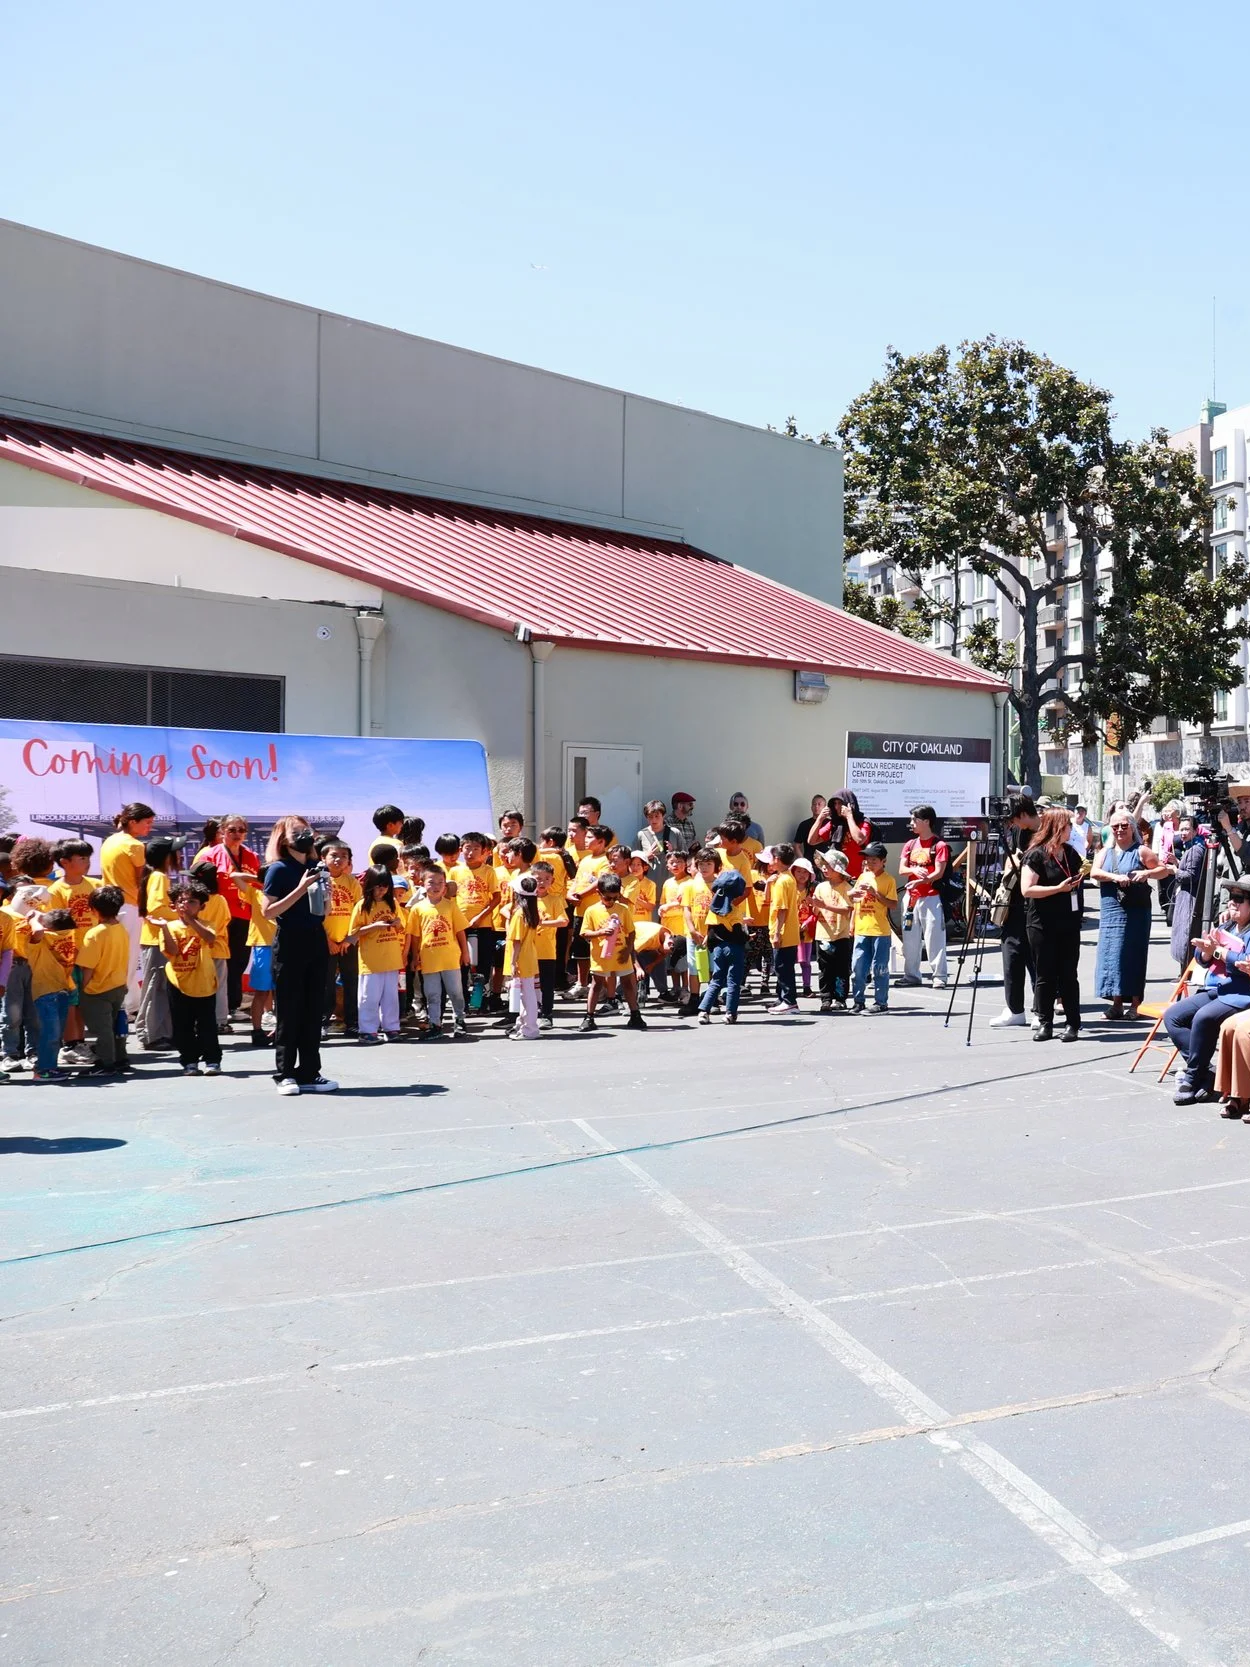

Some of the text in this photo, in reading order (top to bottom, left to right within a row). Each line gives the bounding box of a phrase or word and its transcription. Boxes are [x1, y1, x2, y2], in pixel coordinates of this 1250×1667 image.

[882, 740, 963, 755] CITY OF OAKLAND
[22, 738, 278, 786] Coming Soon!
[852, 761, 916, 770] LINCOLN RECREATION
[852, 769, 876, 777] CENTER
